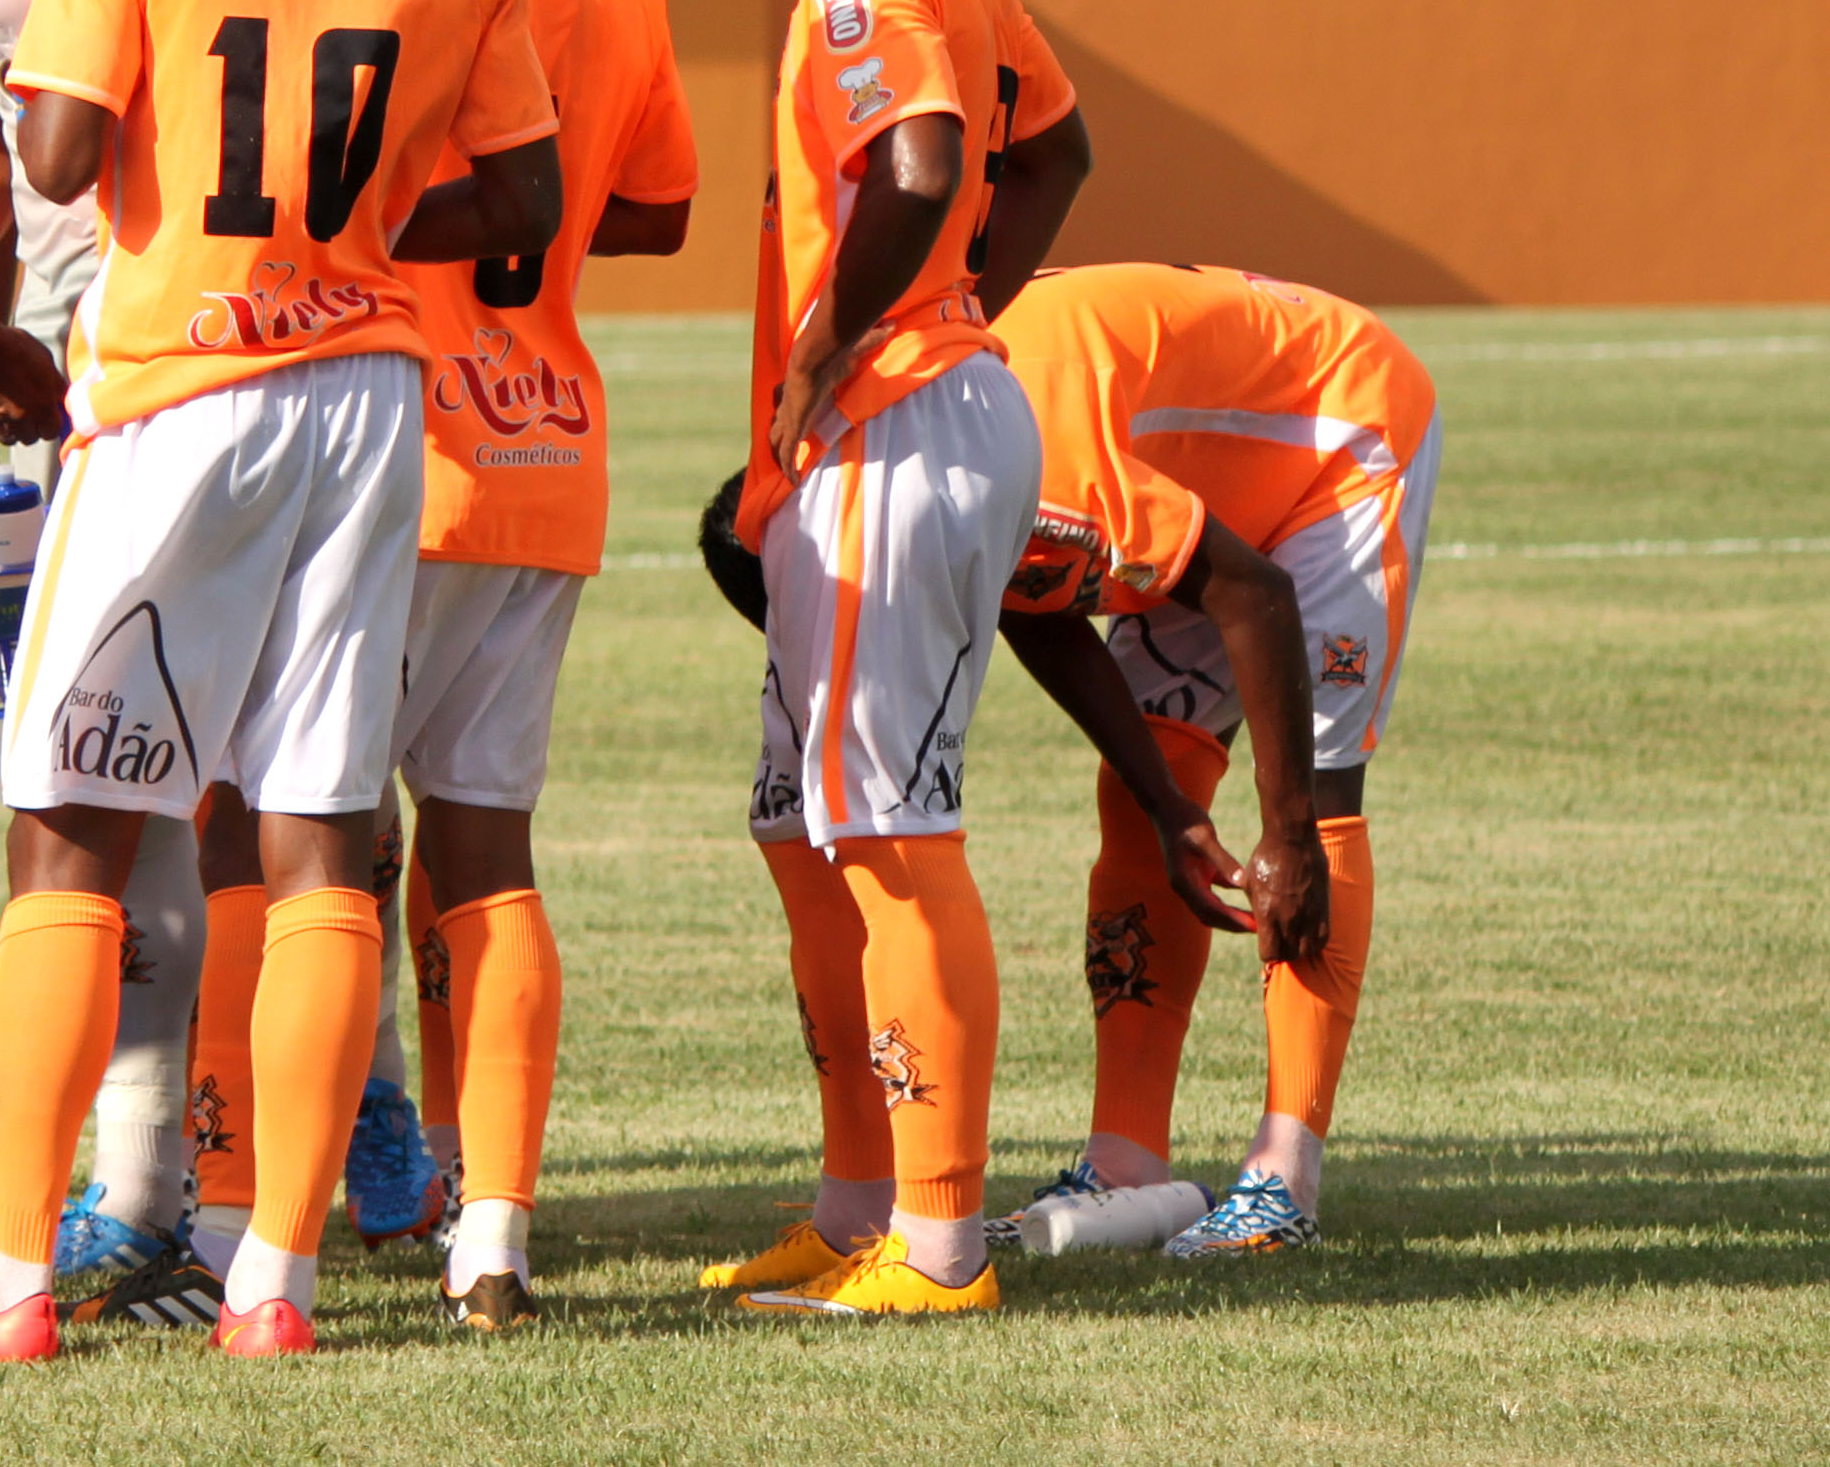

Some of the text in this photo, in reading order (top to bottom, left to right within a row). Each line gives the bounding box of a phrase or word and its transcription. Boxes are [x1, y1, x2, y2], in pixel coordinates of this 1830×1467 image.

[203, 16, 401, 244] 10
[187, 275, 380, 350] Niely
[433, 354, 591, 438] Niely
[475, 441, 582, 467] Cosméticos
[69, 687, 124, 713] Bar do
[54, 713, 176, 785] Adão
